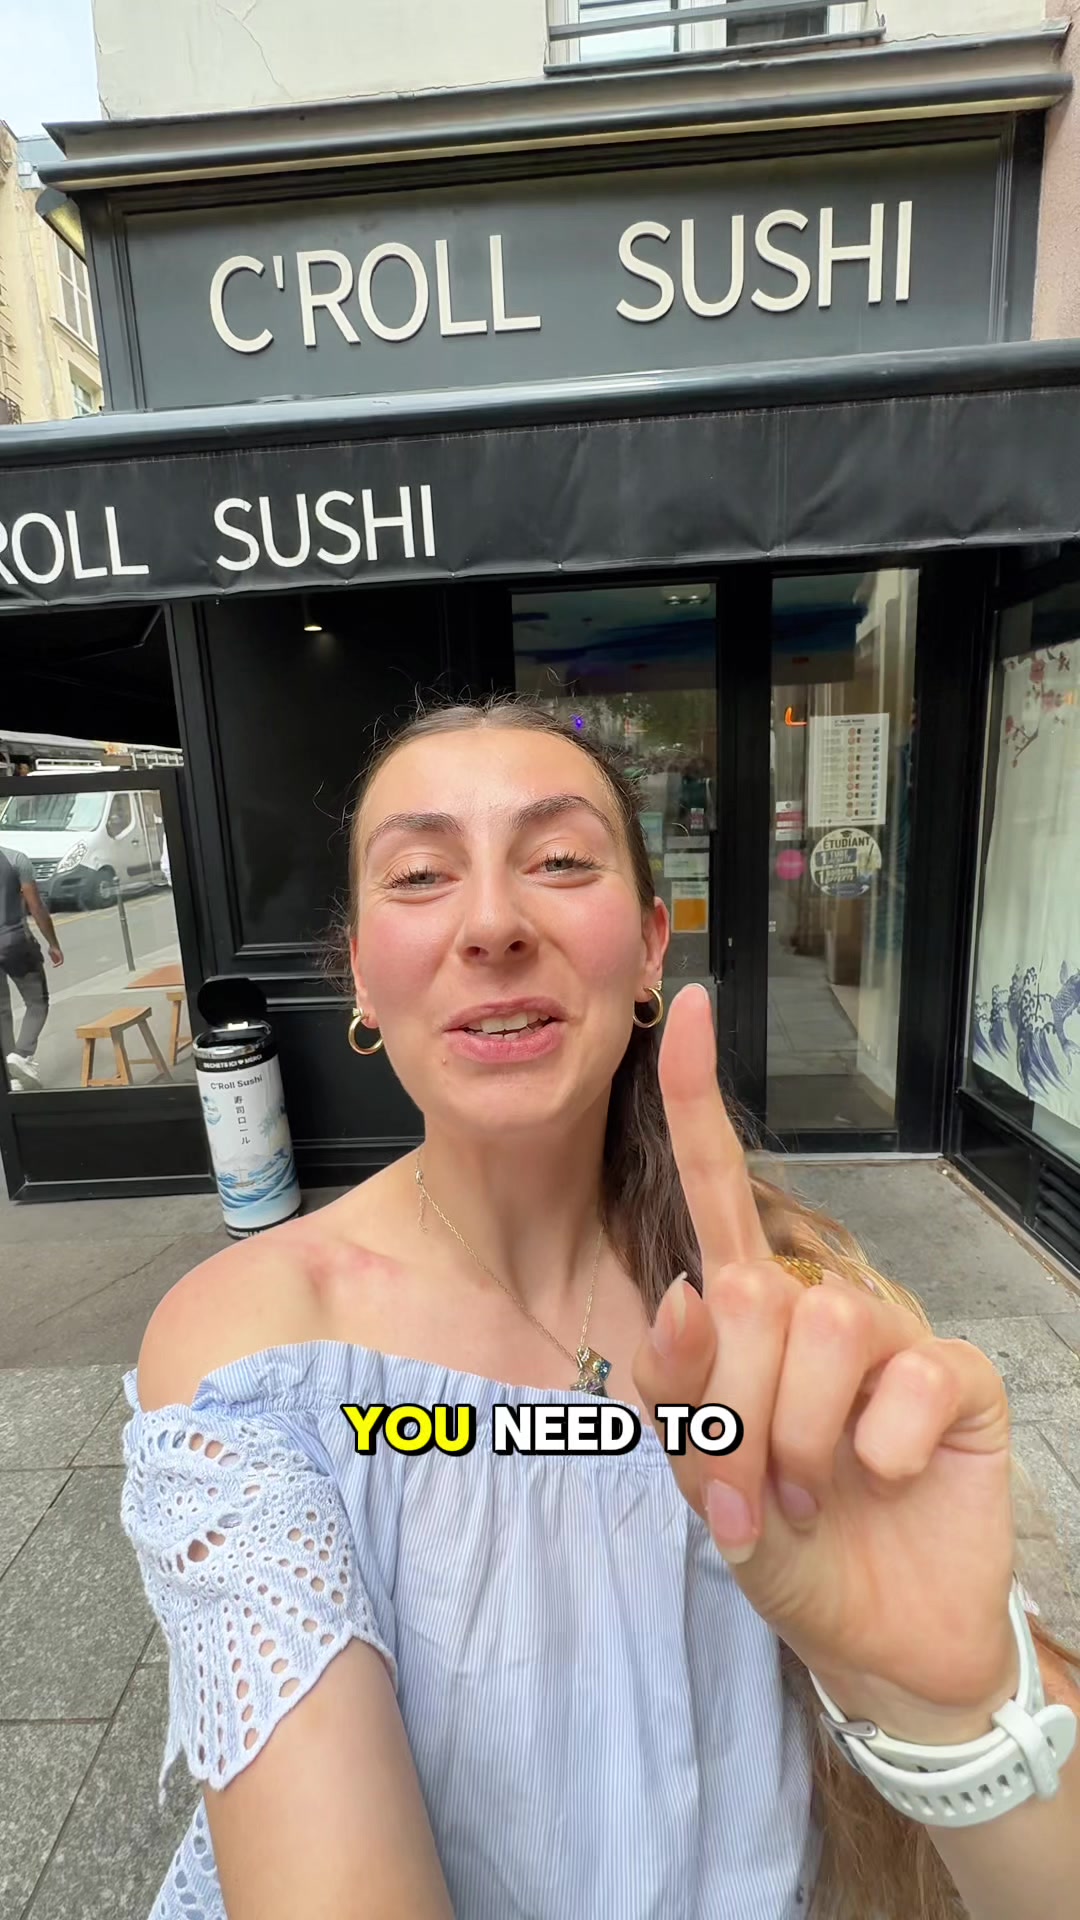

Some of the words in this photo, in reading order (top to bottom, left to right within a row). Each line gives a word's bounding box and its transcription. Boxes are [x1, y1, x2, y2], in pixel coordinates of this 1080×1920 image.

[209, 234, 542, 354] C'ROLL
[616, 200, 913, 323] SUSHI
[213, 484, 436, 572] SUSHI
[823, 836, 870, 849] ÉTUDIANT
[210, 1080, 236, 1090] C'Roll
[237, 1074, 263, 1088] Sushi
